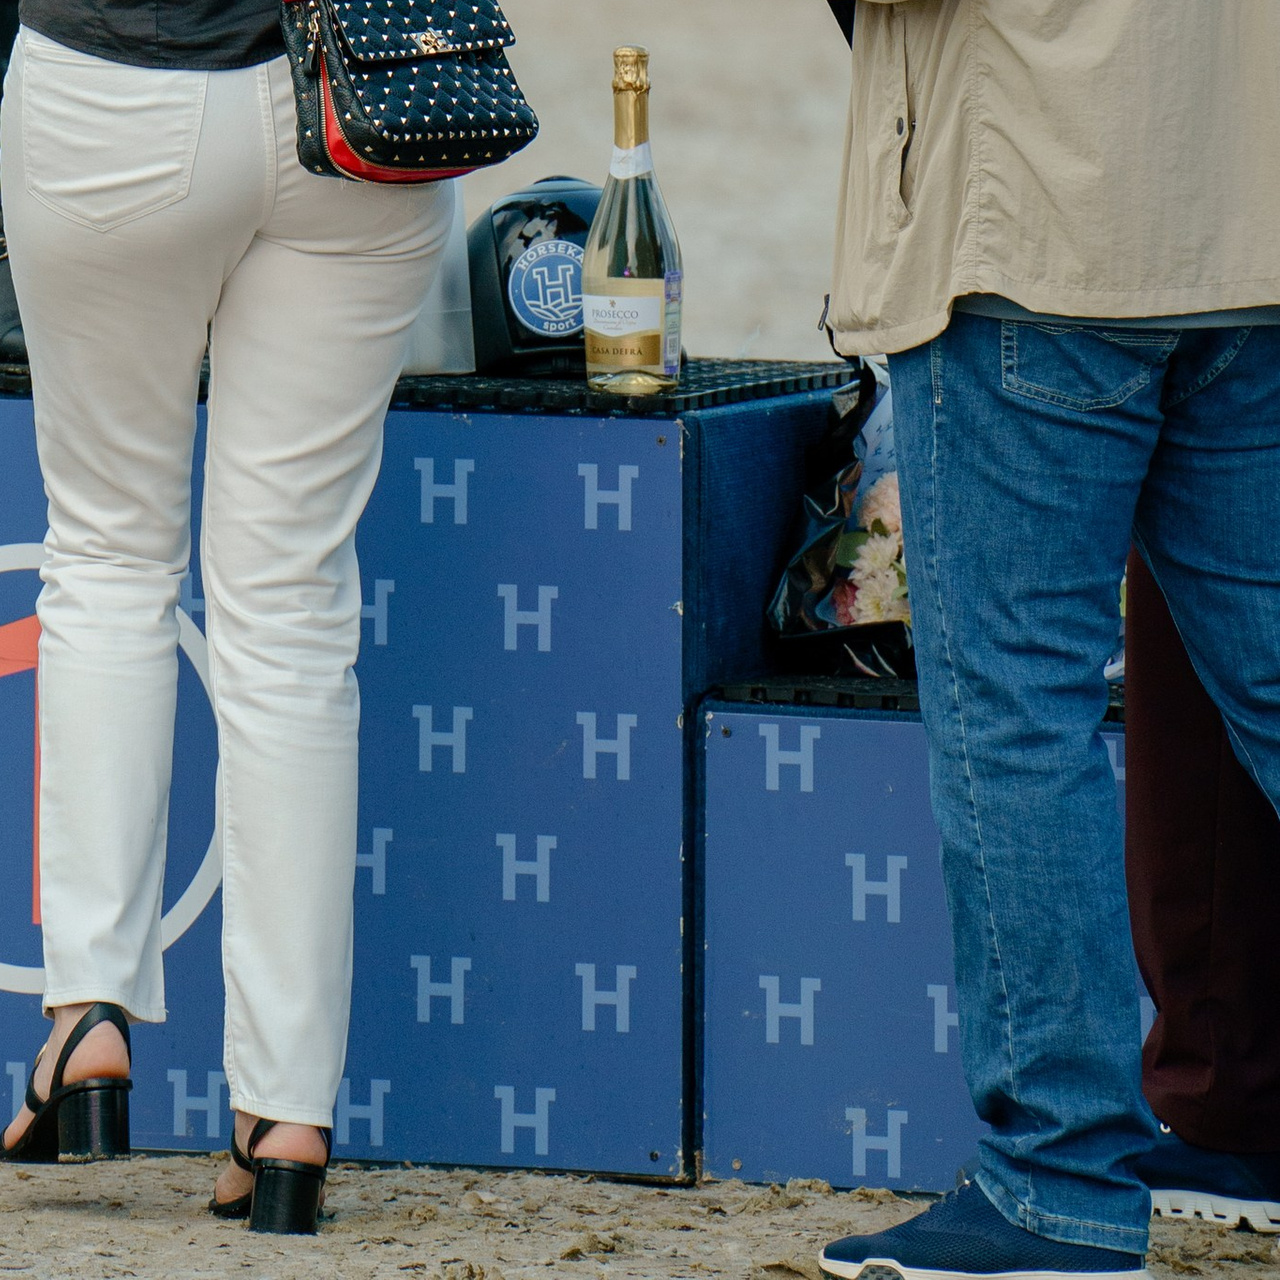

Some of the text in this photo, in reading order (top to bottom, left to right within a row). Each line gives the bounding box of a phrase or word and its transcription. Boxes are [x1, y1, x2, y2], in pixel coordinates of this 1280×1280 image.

[542, 316, 577, 332] sport
[591, 308, 639, 319] PROSECCO
[414, 458, 475, 524] H
[577, 463, 640, 531] H
[497, 584, 559, 652] H
[412, 705, 473, 773] H
[576, 711, 638, 781] H
[758, 723, 821, 793] H
[495, 833, 558, 903] H
[844, 852, 908, 924] H
[410, 955, 472, 1025] H
[575, 962, 637, 1033] H
[758, 974, 822, 1046] H
[167, 1069, 229, 1138] H
[335, 1076, 392, 1147] H
[494, 1085, 556, 1156] H
[844, 1106, 909, 1179] H
